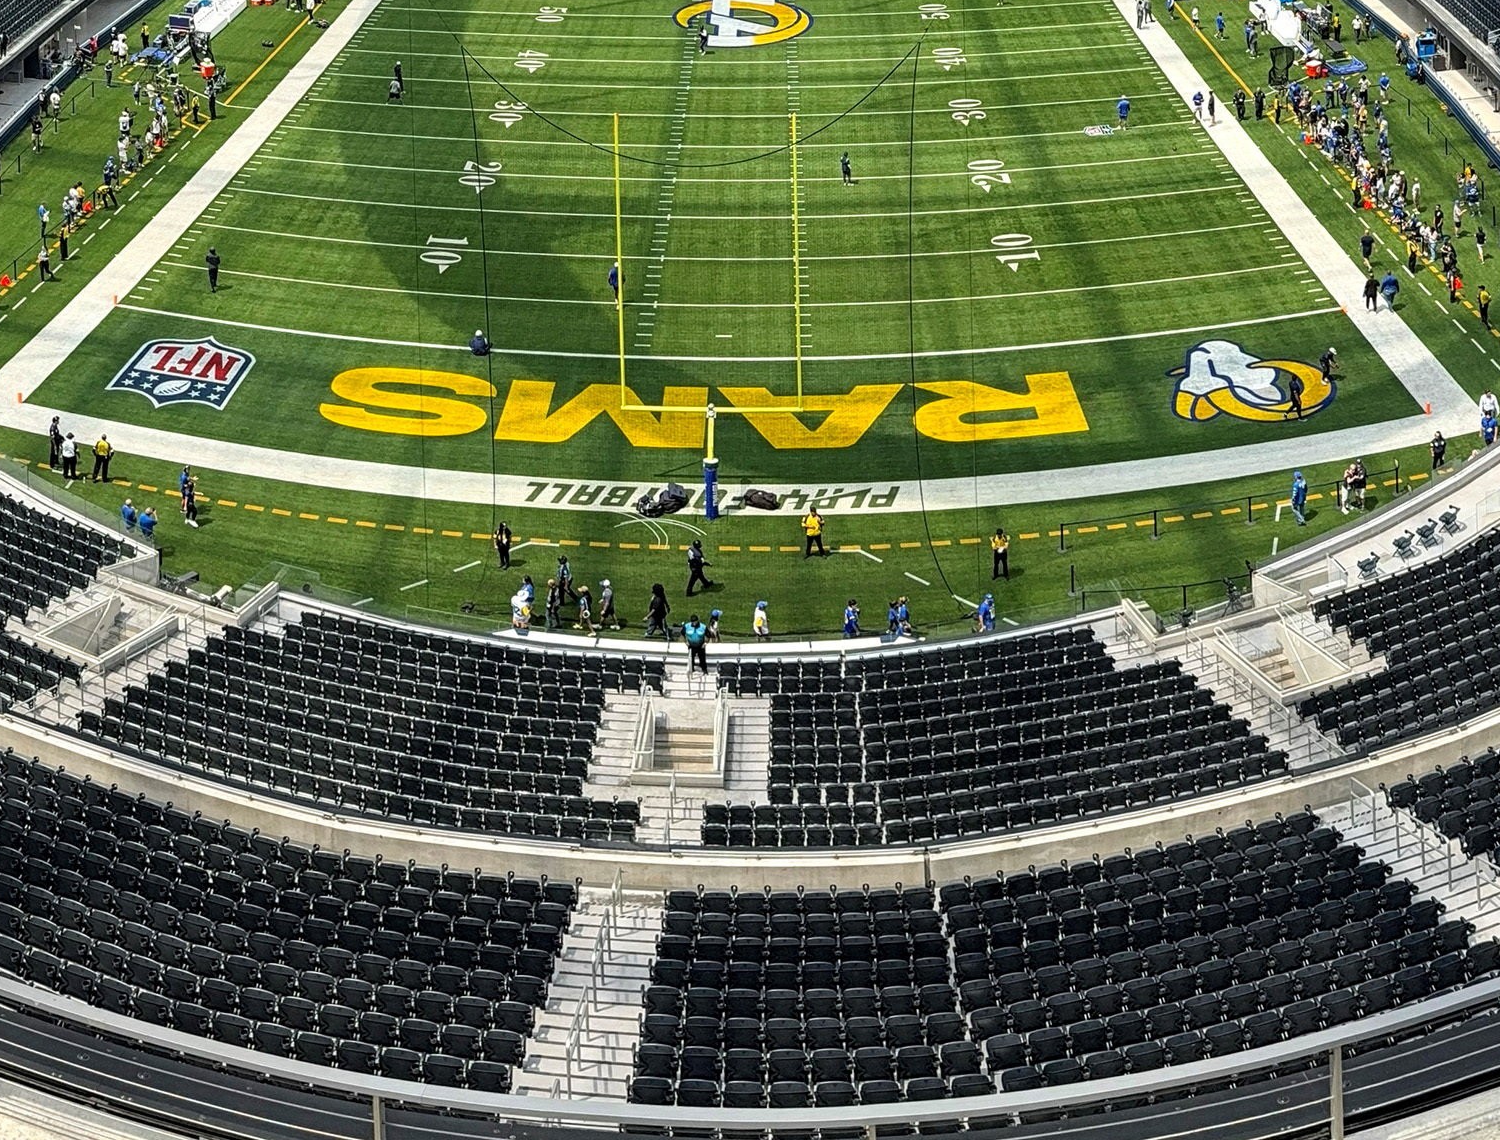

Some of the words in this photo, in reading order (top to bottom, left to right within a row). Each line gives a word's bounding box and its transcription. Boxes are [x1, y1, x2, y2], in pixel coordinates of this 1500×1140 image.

[535, 6, 568, 23] 50
[918, 3, 950, 21] 50
[513, 49, 549, 69] 40
[932, 47, 967, 66] 40
[488, 100, 529, 123] 30
[948, 98, 986, 121] 30
[458, 160, 502, 189] 20
[967, 159, 1011, 187] 20
[420, 234, 469, 268] 10
[989, 233, 1040, 264] 10
[152, 346, 242, 382] NFL
[319, 366, 1090, 450] RAMS
